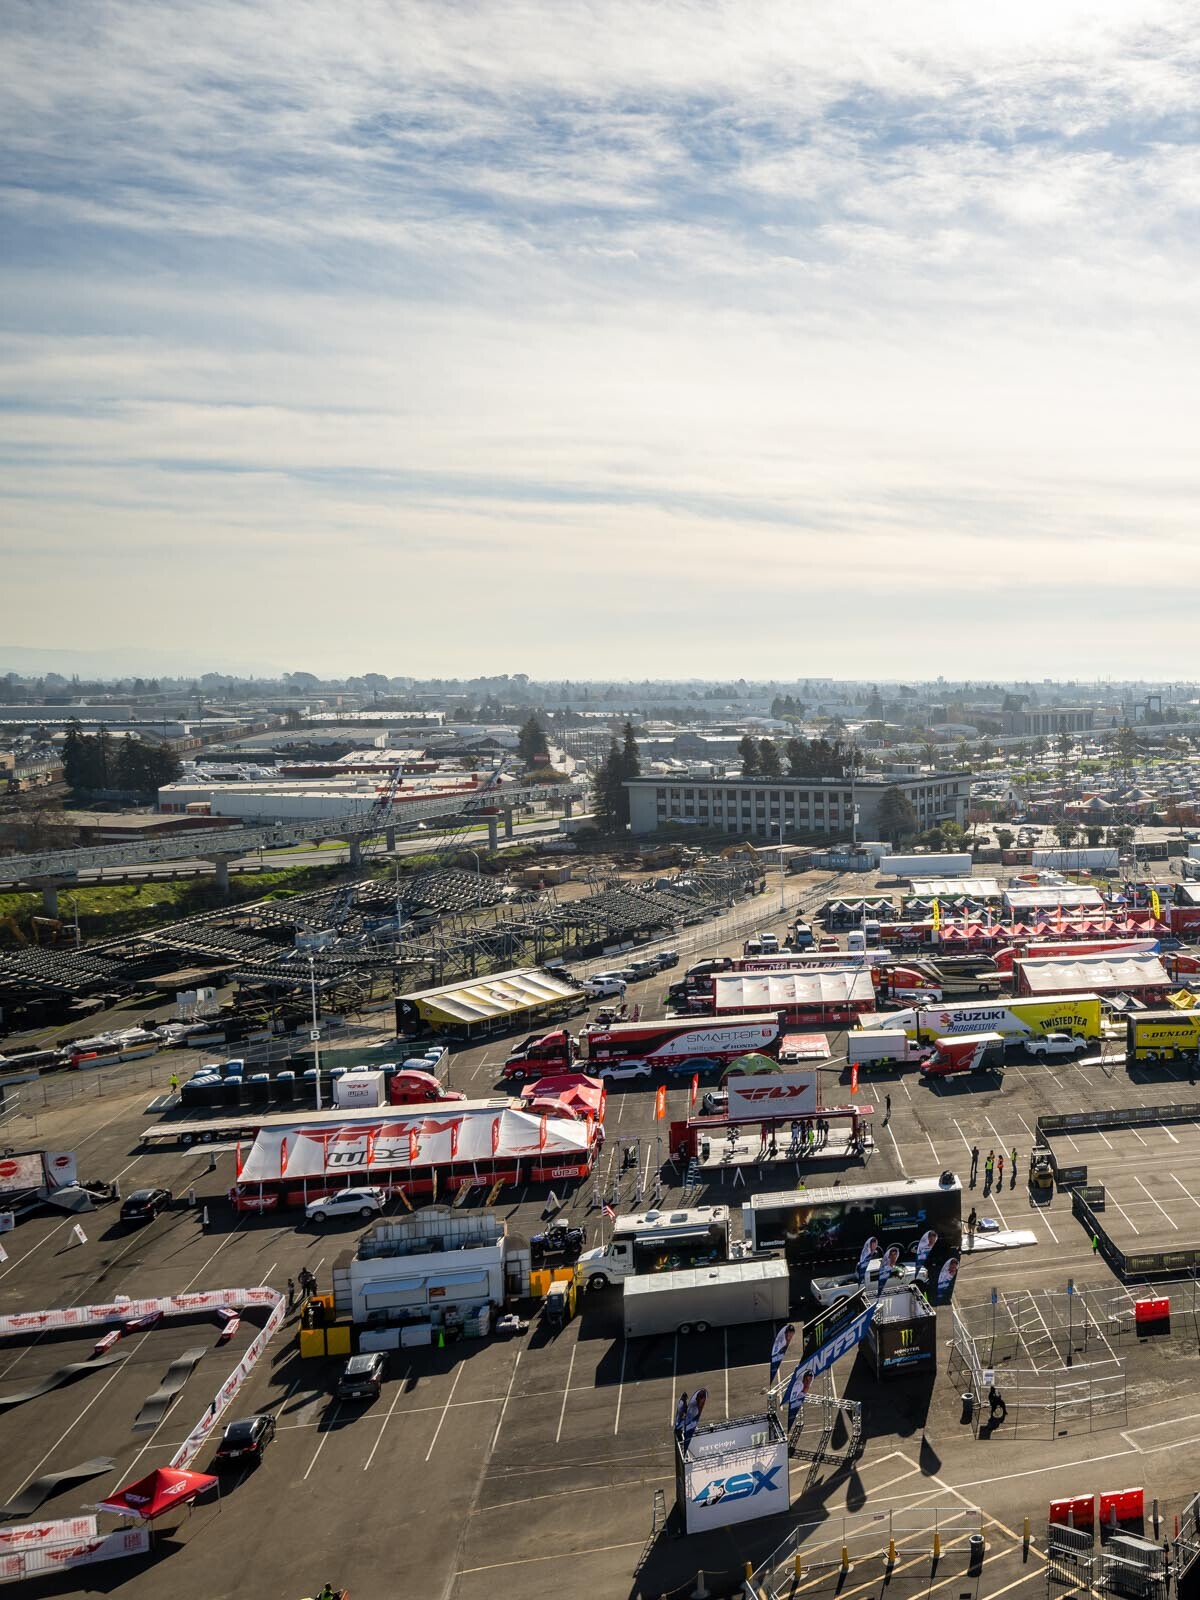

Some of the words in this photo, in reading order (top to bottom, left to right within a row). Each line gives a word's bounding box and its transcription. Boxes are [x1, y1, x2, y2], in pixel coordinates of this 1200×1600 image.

[954, 1011, 1005, 1023] SUZUKI
[1040, 1016, 1073, 1030] TWISTED
[1074, 1015, 1088, 1027] TEA
[947, 1022, 998, 1033] PROGRESSIVE
[310, 1030, 320, 1040] B
[1151, 1030, 1197, 1038] DUNLOP
[735, 1084, 810, 1100] FLY
[552, 1167, 579, 1178] WPS
[45, 1541, 105, 1560] FLY
